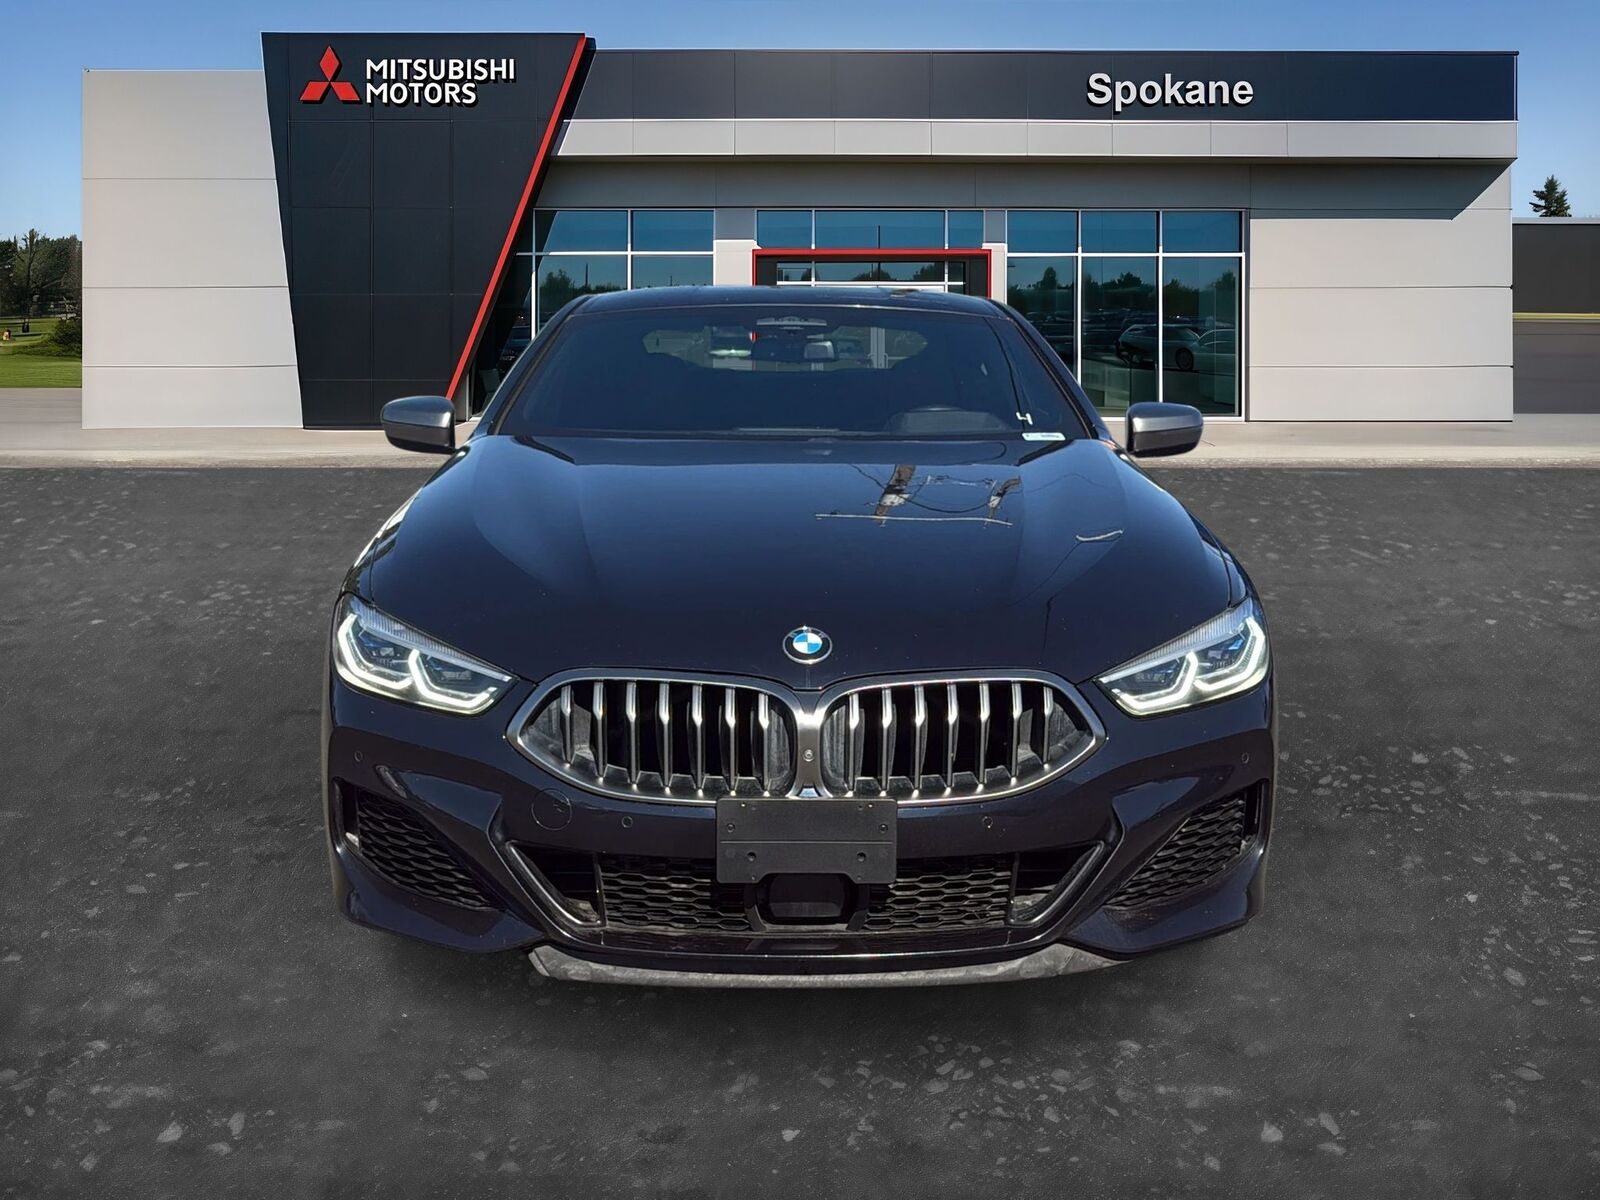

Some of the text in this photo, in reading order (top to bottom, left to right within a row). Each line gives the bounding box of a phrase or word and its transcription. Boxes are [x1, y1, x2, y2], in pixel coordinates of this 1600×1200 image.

[365, 58, 516, 80] MITSUBISHI
[365, 82, 477, 104] MOTORS
[1087, 72, 1254, 112] Spokane
